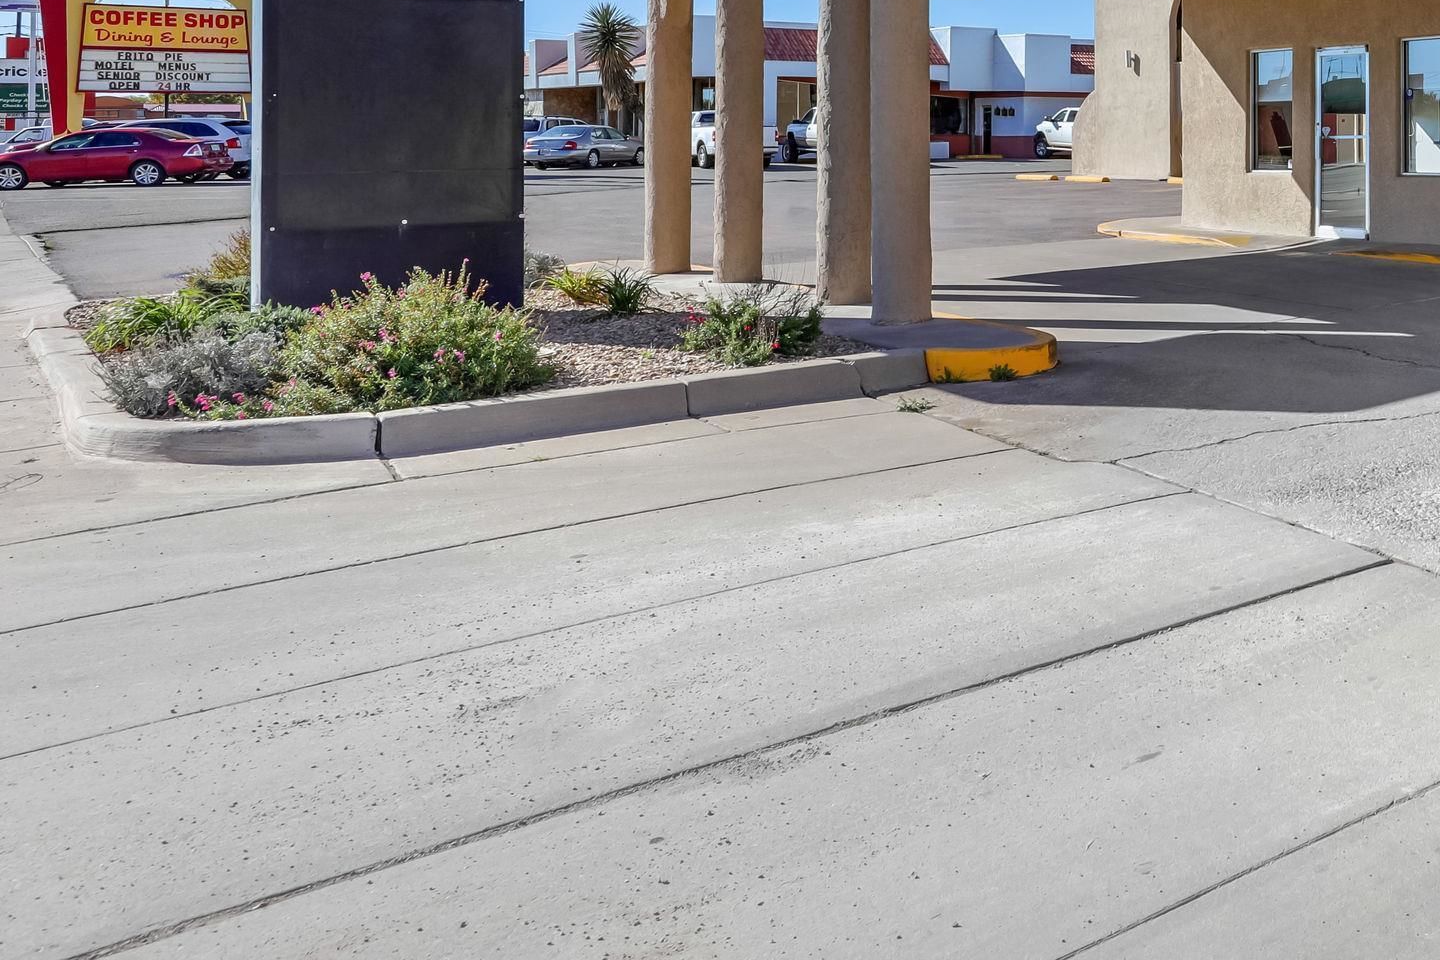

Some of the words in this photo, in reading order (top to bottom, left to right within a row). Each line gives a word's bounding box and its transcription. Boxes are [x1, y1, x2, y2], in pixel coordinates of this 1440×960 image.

[90, 9, 178, 27] COFFEE
[184, 13, 244, 29] SHOP
[94, 28, 153, 46] Dining
[160, 31, 175, 43] &
[181, 31, 240, 48] Lounge
[117, 51, 154, 61] FRITO
[164, 52, 183, 62] PIE
[94, 61, 135, 71] MOTEL
[158, 62, 197, 71] MENUS
[97, 71, 141, 81] SENIOR
[155, 72, 211, 82] DISCOUNT
[108, 81, 141, 90] OPEN
[157, 82, 171, 91] 24
[175, 82, 191, 91] HR
